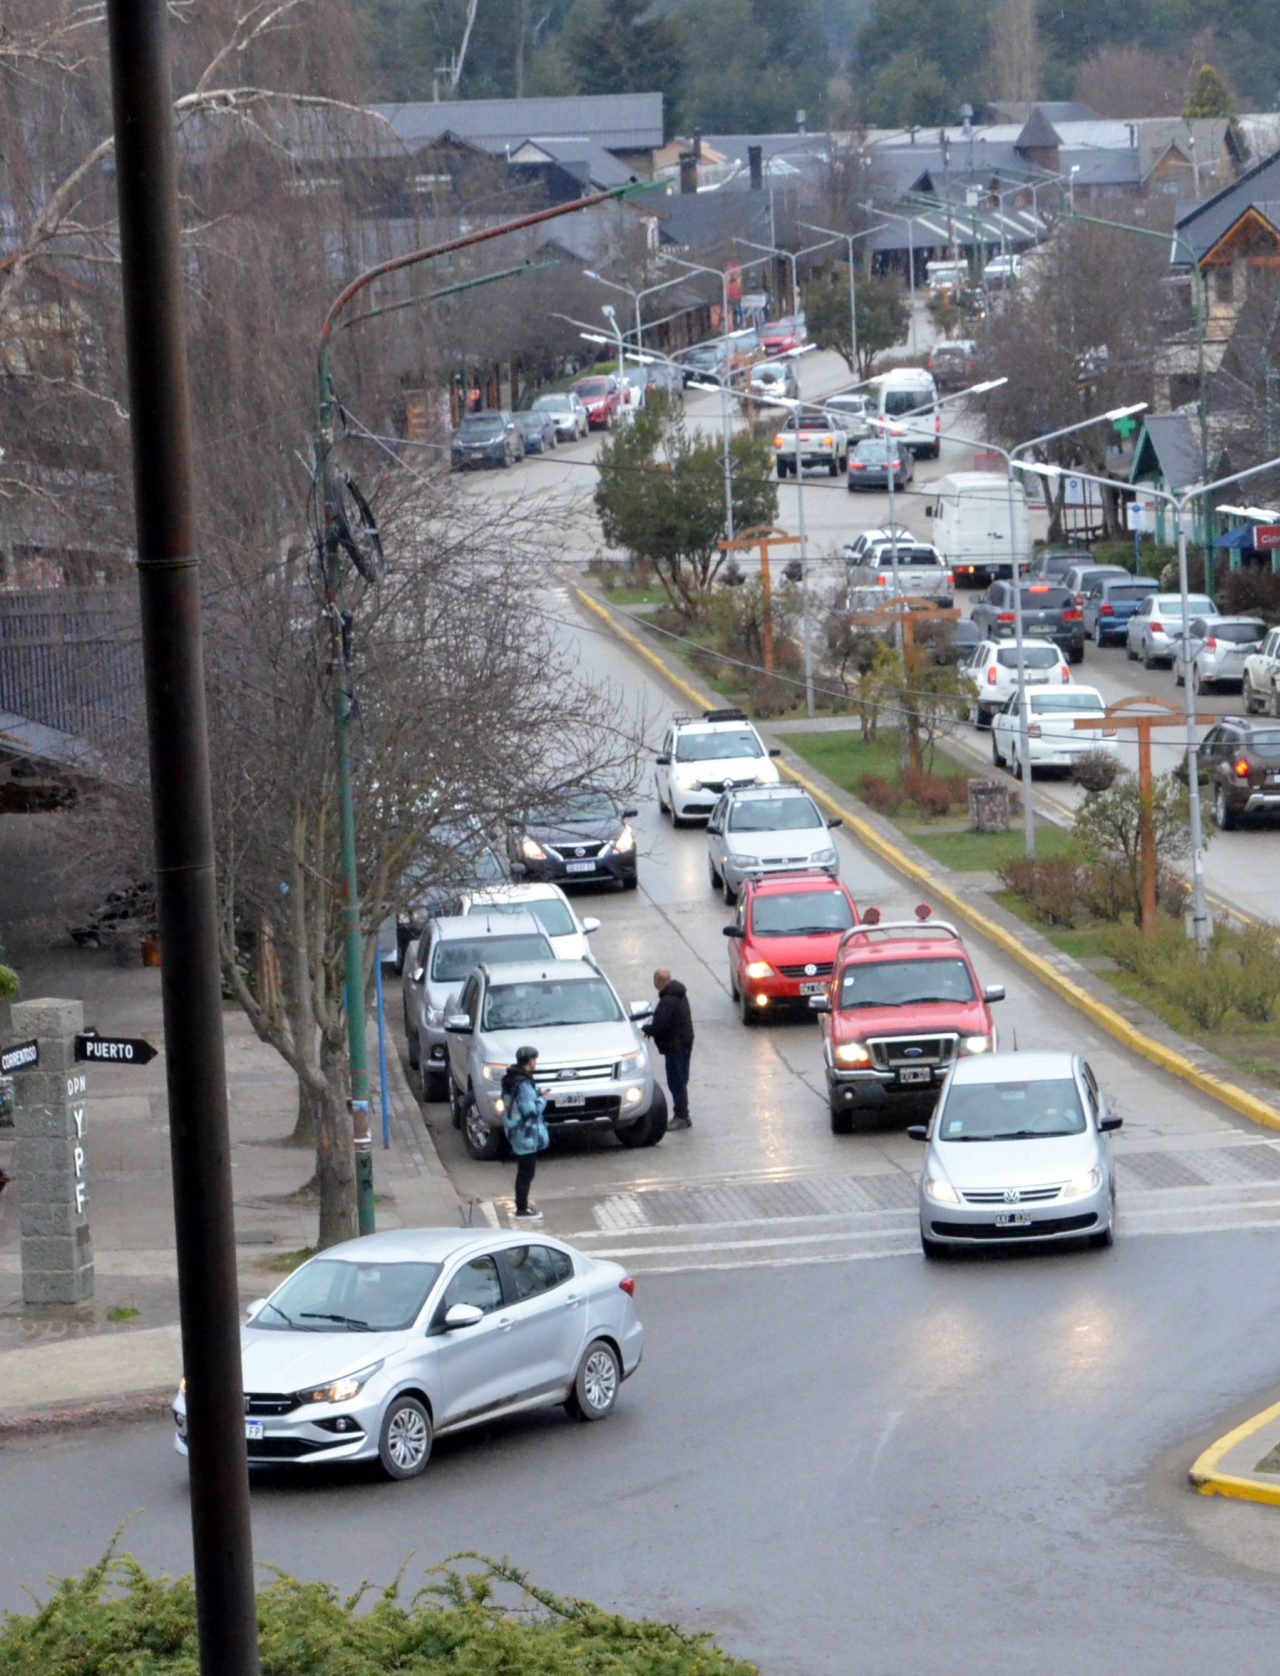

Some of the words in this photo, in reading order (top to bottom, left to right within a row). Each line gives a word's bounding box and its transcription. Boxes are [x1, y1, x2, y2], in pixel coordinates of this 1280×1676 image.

[2, 1045, 38, 1071] CORRENTOSO
[86, 1041, 134, 1059] PUERTO
[67, 1074, 87, 1096] DPN
